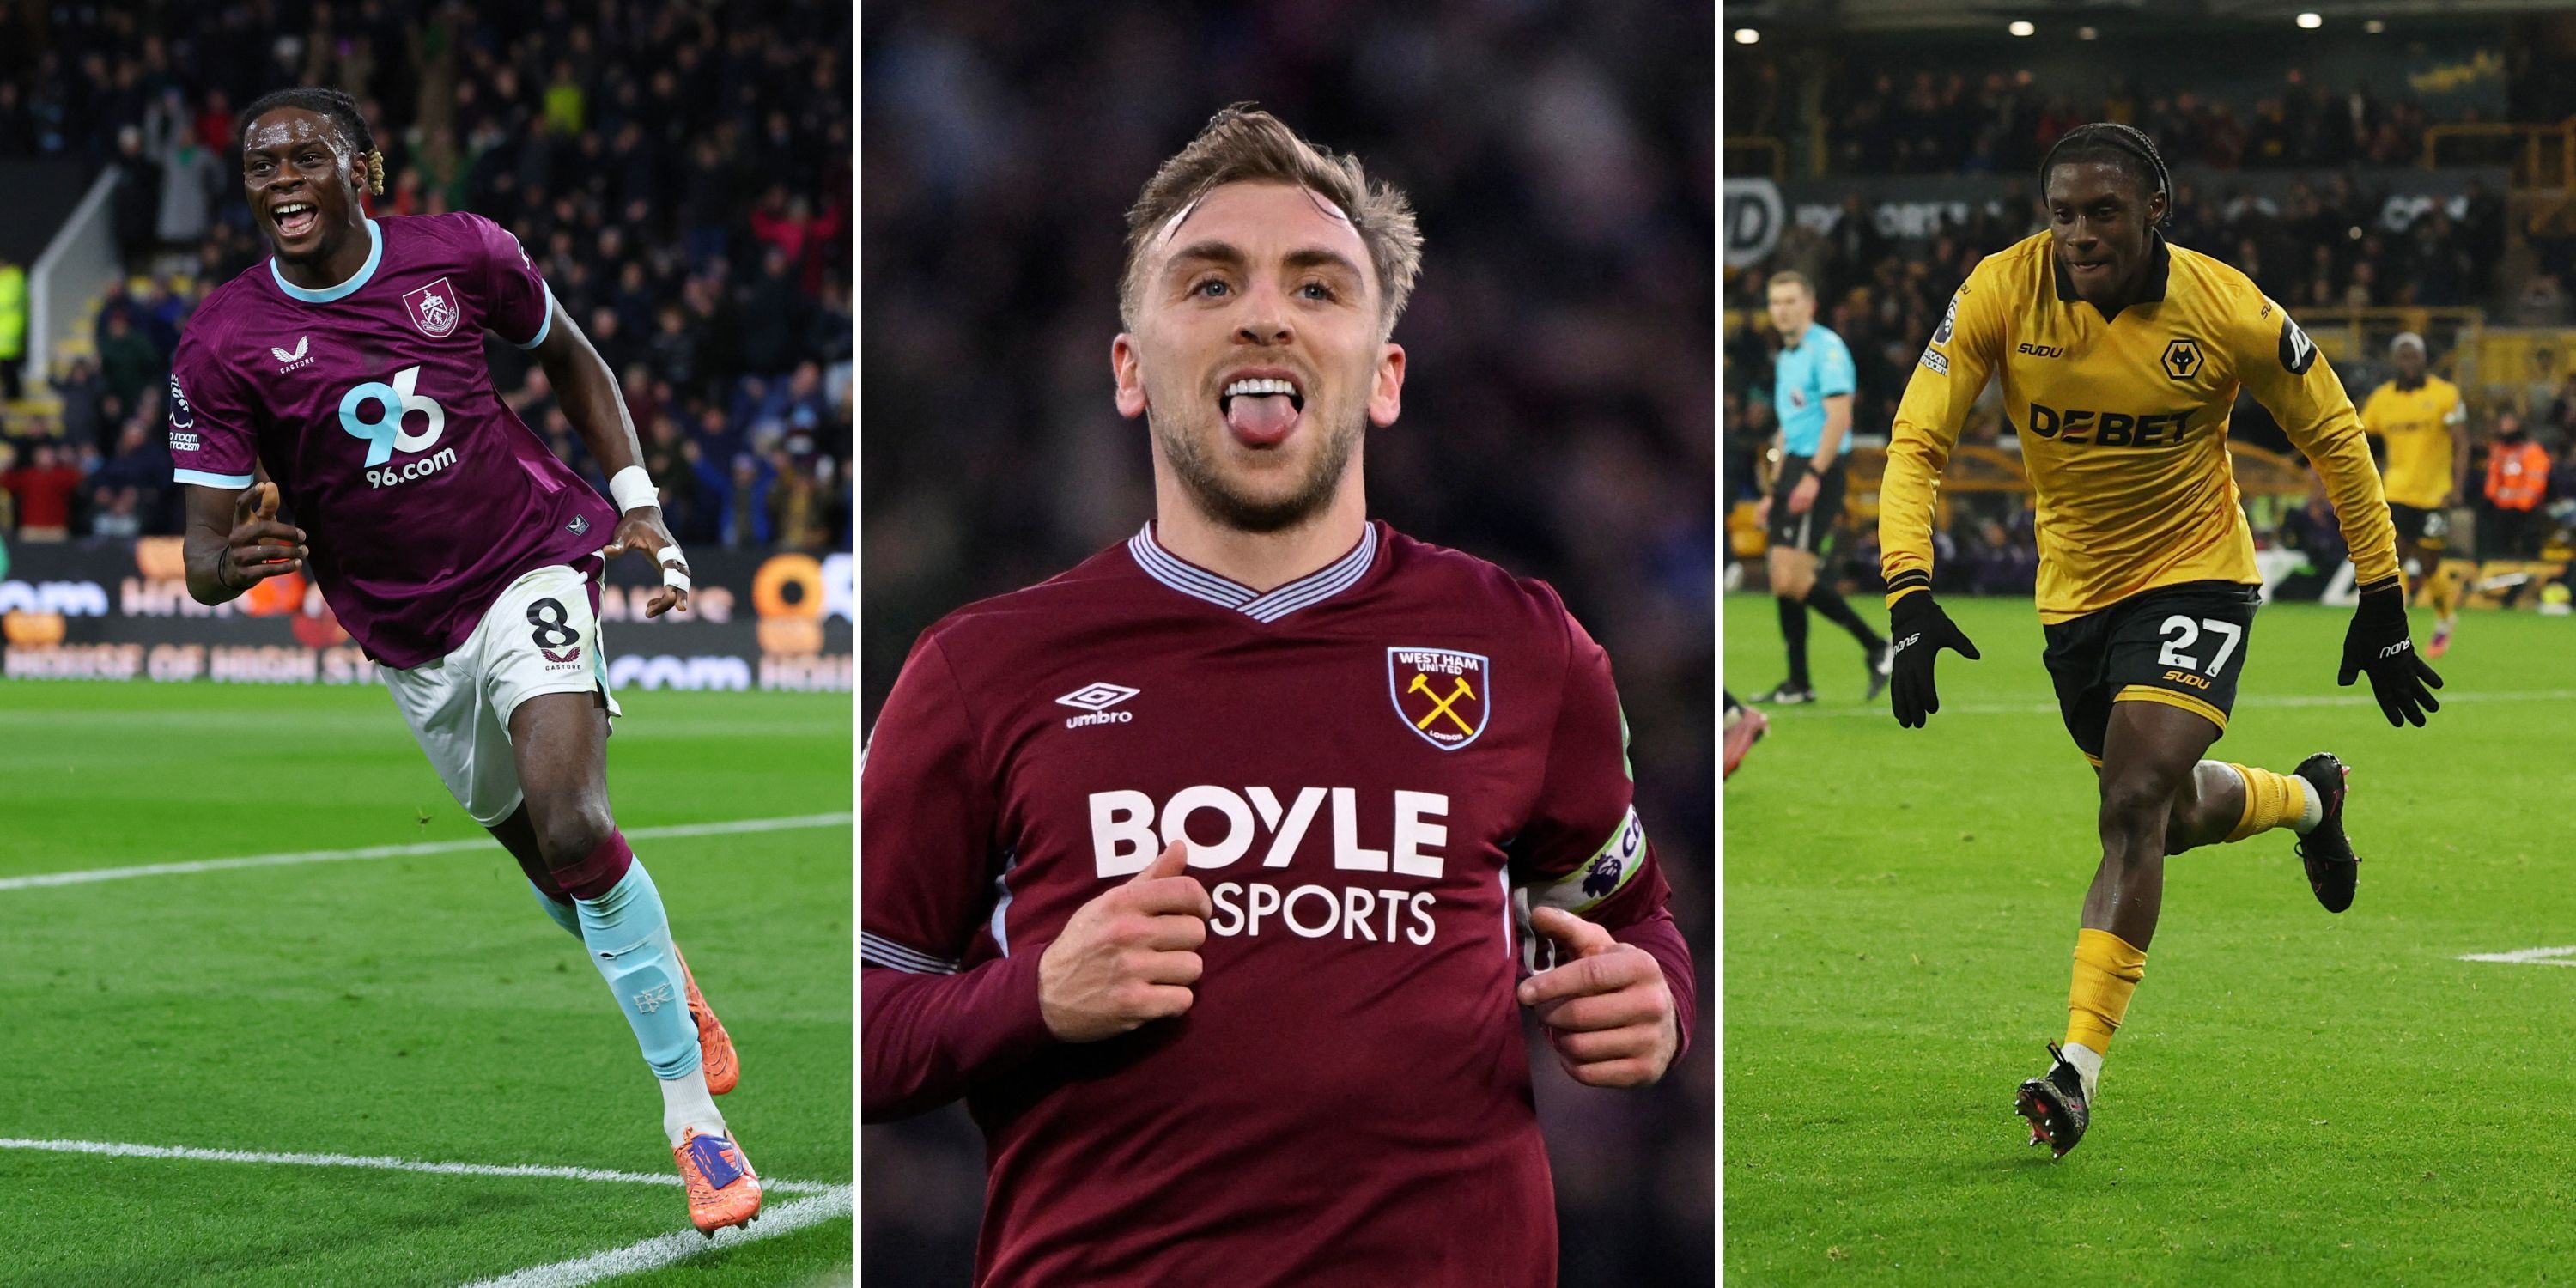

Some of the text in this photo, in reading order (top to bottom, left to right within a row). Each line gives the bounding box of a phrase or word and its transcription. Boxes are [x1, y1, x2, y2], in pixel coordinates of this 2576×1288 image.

[2018, 343, 2063, 358] SUDU
[280, 356, 315, 374] CASTORE
[338, 365, 445, 468] 96
[2030, 403, 2199, 447] DEBET
[173, 441, 200, 451] racism
[174, 432, 198, 443] room
[366, 447, 457, 489] 96.com
[526, 598, 580, 648] 8
[2158, 614, 2242, 678] 27
[1399, 653, 1479, 671] WEST HAM
[1417, 663, 1463, 675] UNITED
[2161, 670, 2212, 690] SUDU
[1066, 710, 1133, 729] umbro
[1429, 730, 1463, 741] LONDON
[1089, 785, 1449, 879] BOYLE
[1210, 882, 1437, 945] SPORTS
